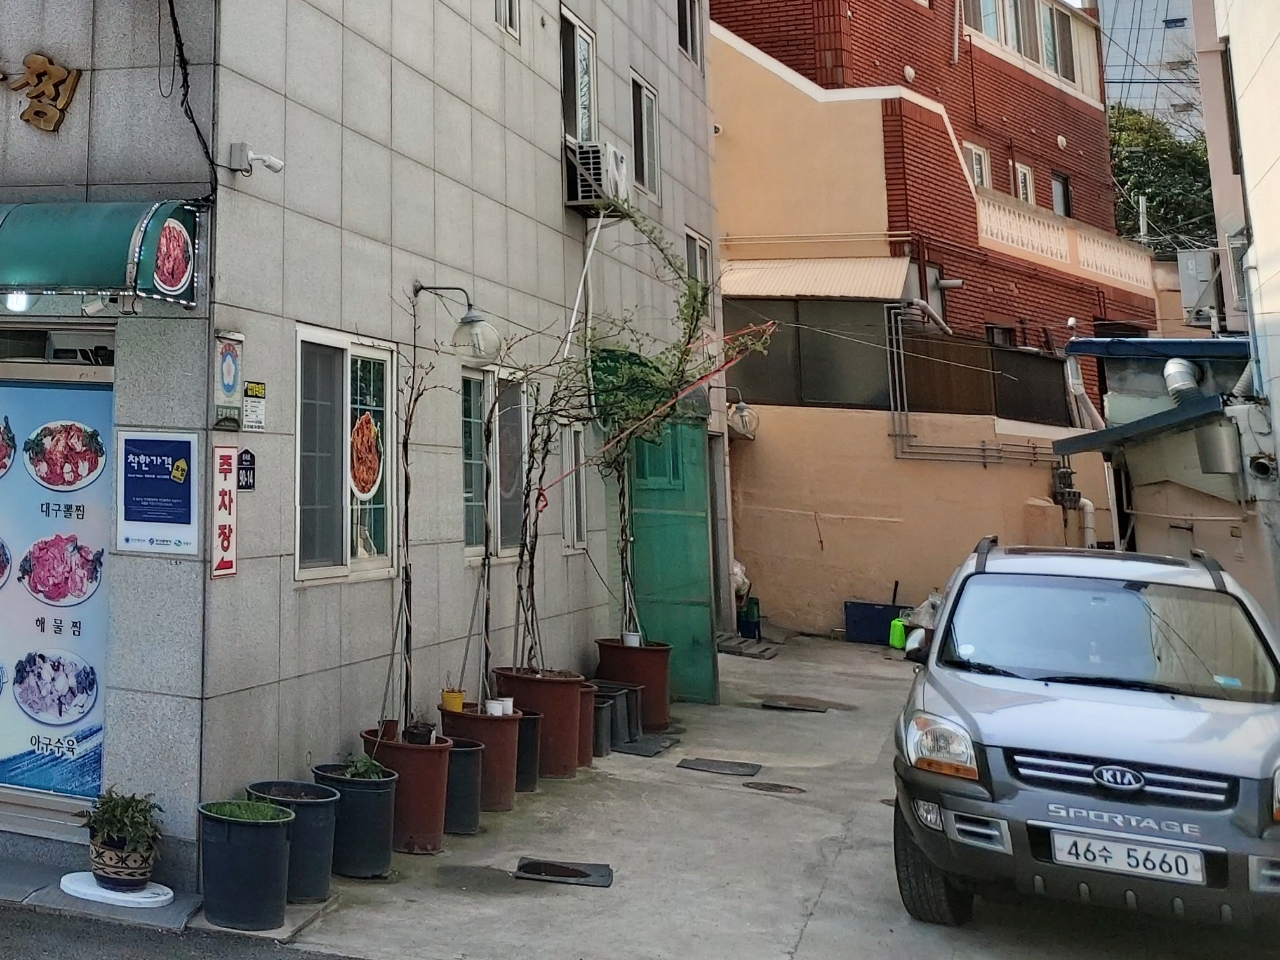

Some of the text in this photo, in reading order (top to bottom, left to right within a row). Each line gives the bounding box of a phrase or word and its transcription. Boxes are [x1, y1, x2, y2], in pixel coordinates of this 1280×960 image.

[127, 453, 173, 472] 착한가격
[239, 469, 254, 486] 90-14
[218, 454, 234, 553] 주차장
[30, 734, 77, 756] 아구수육
[1102, 768, 1136, 785] KIA
[1047, 803, 1202, 837] SPORTAGE
[1067, 839, 1189, 876] 46수 5660
